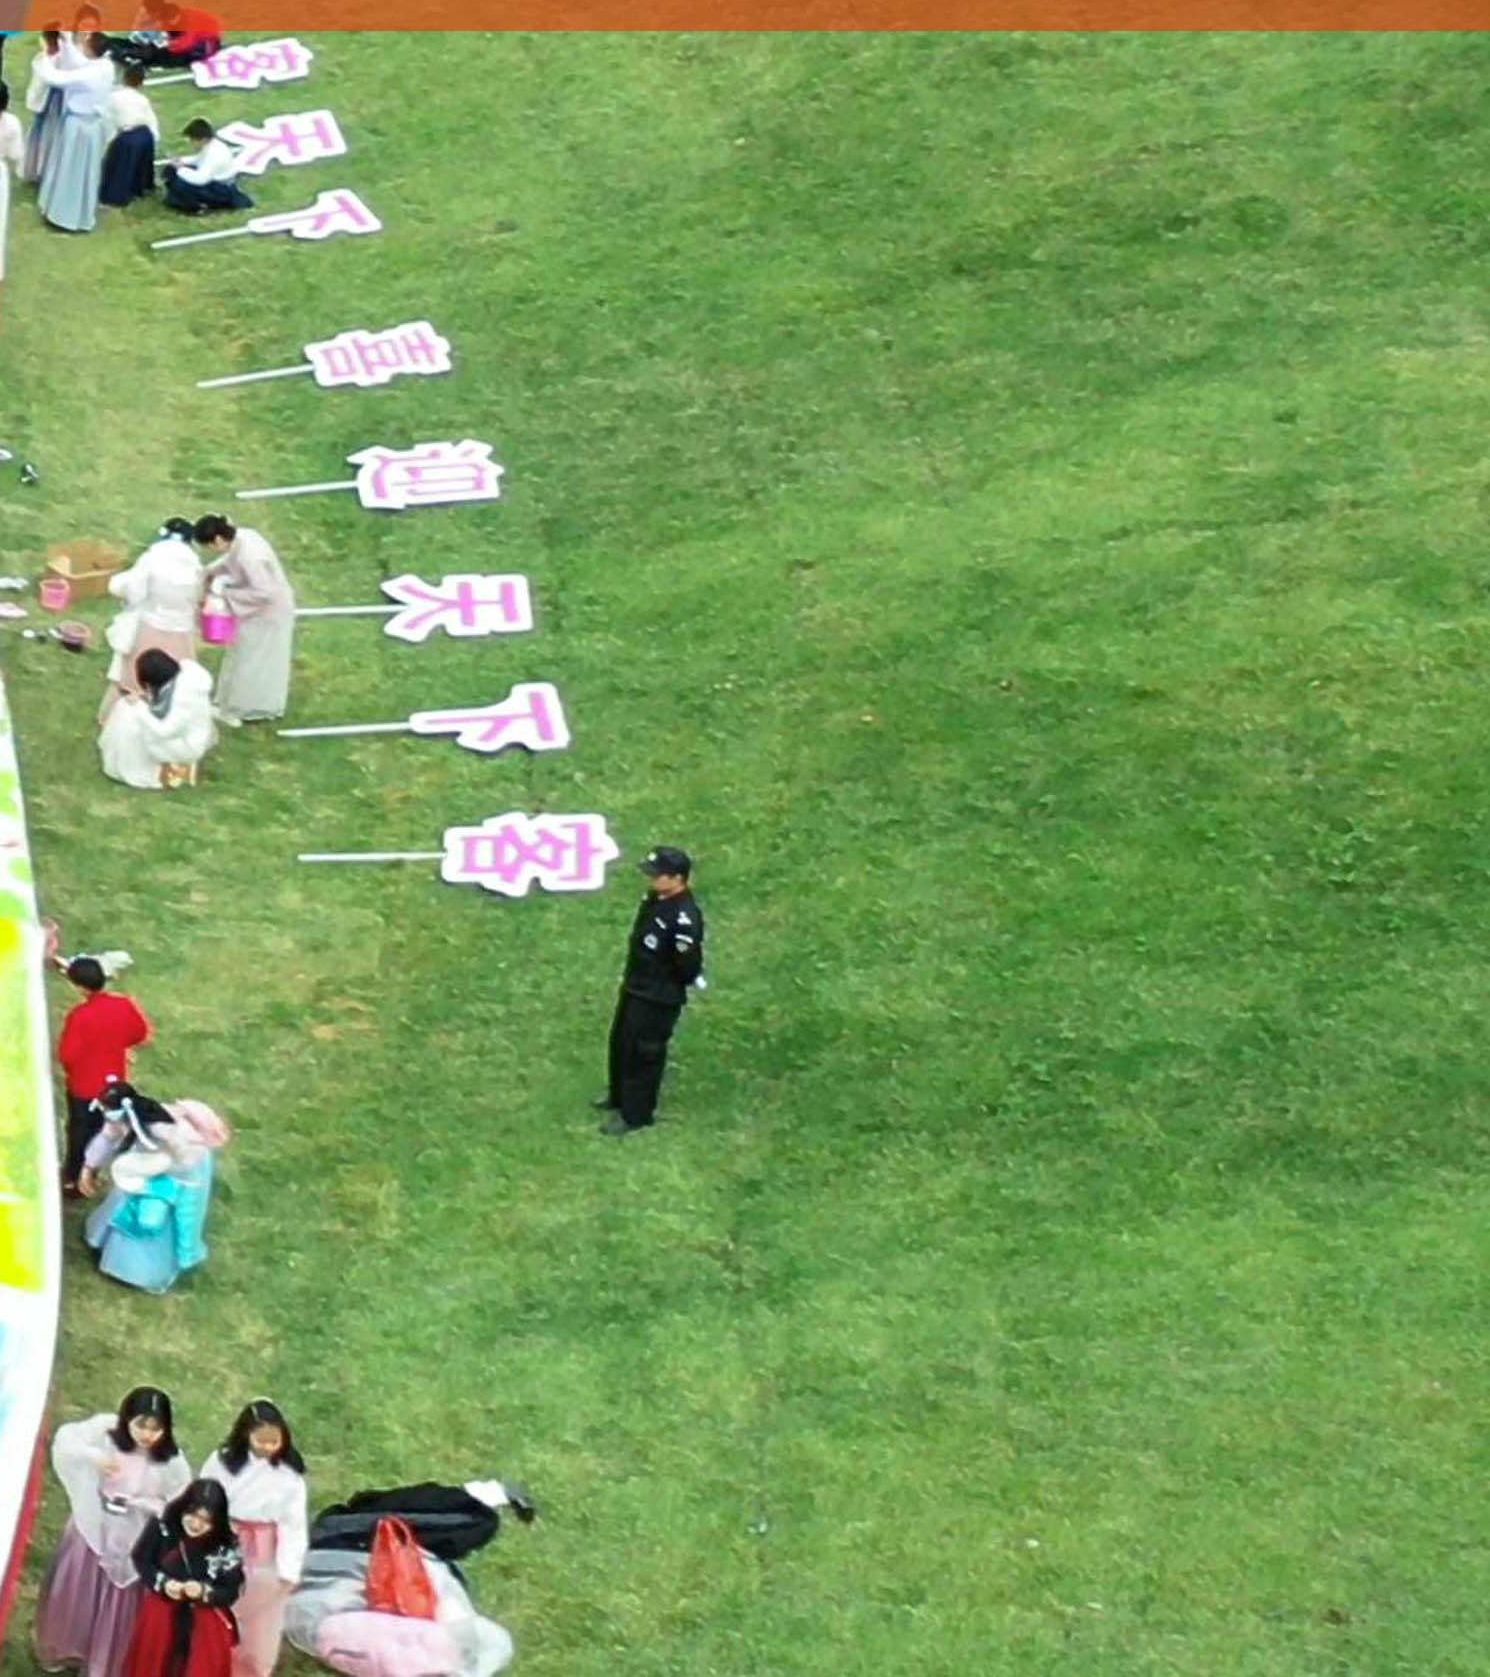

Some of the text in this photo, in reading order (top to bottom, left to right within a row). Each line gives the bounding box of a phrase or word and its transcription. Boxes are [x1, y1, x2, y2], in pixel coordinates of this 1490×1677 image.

[233, 117, 333, 166] 天
[263, 195, 368, 231] 下
[319, 329, 438, 376] 喜
[367, 446, 487, 499] 迎
[400, 581, 521, 630] 天
[425, 690, 556, 743] 下
[460, 820, 604, 884] 客
